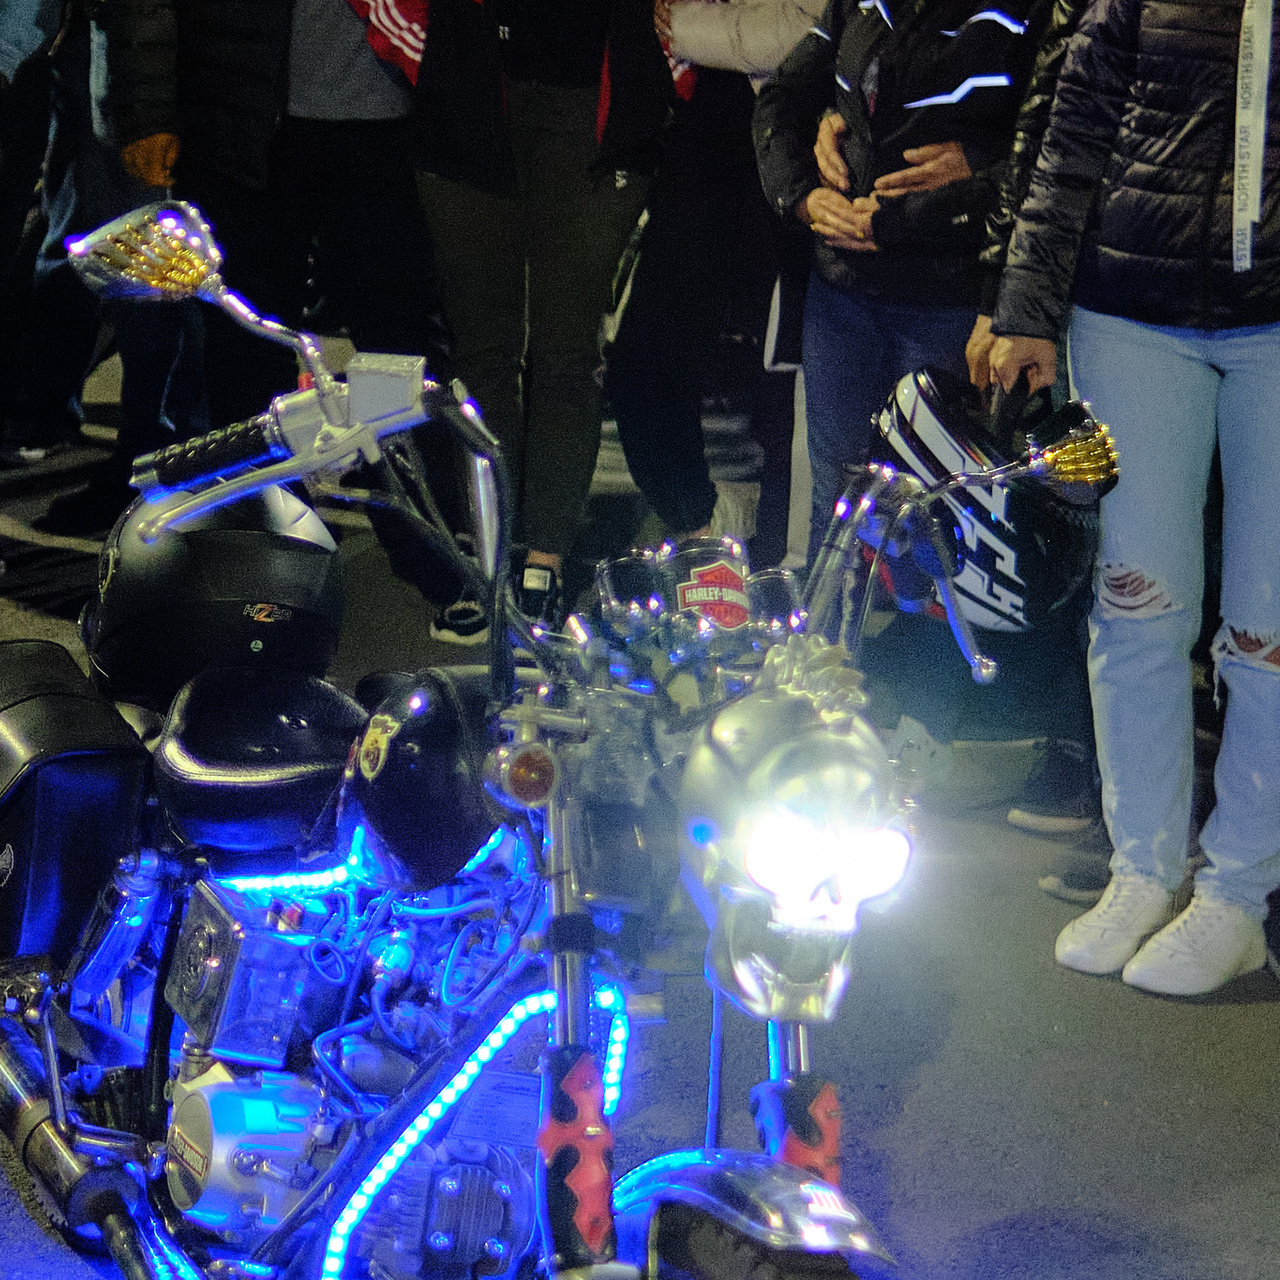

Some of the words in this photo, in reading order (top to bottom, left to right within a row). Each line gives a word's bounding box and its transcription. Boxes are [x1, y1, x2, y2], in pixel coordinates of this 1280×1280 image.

[1242, 25, 1254, 61] STAR
[1238, 124, 1251, 160] STAR
[1237, 164, 1249, 213] NORTH
[1236, 227, 1248, 262] STAR
